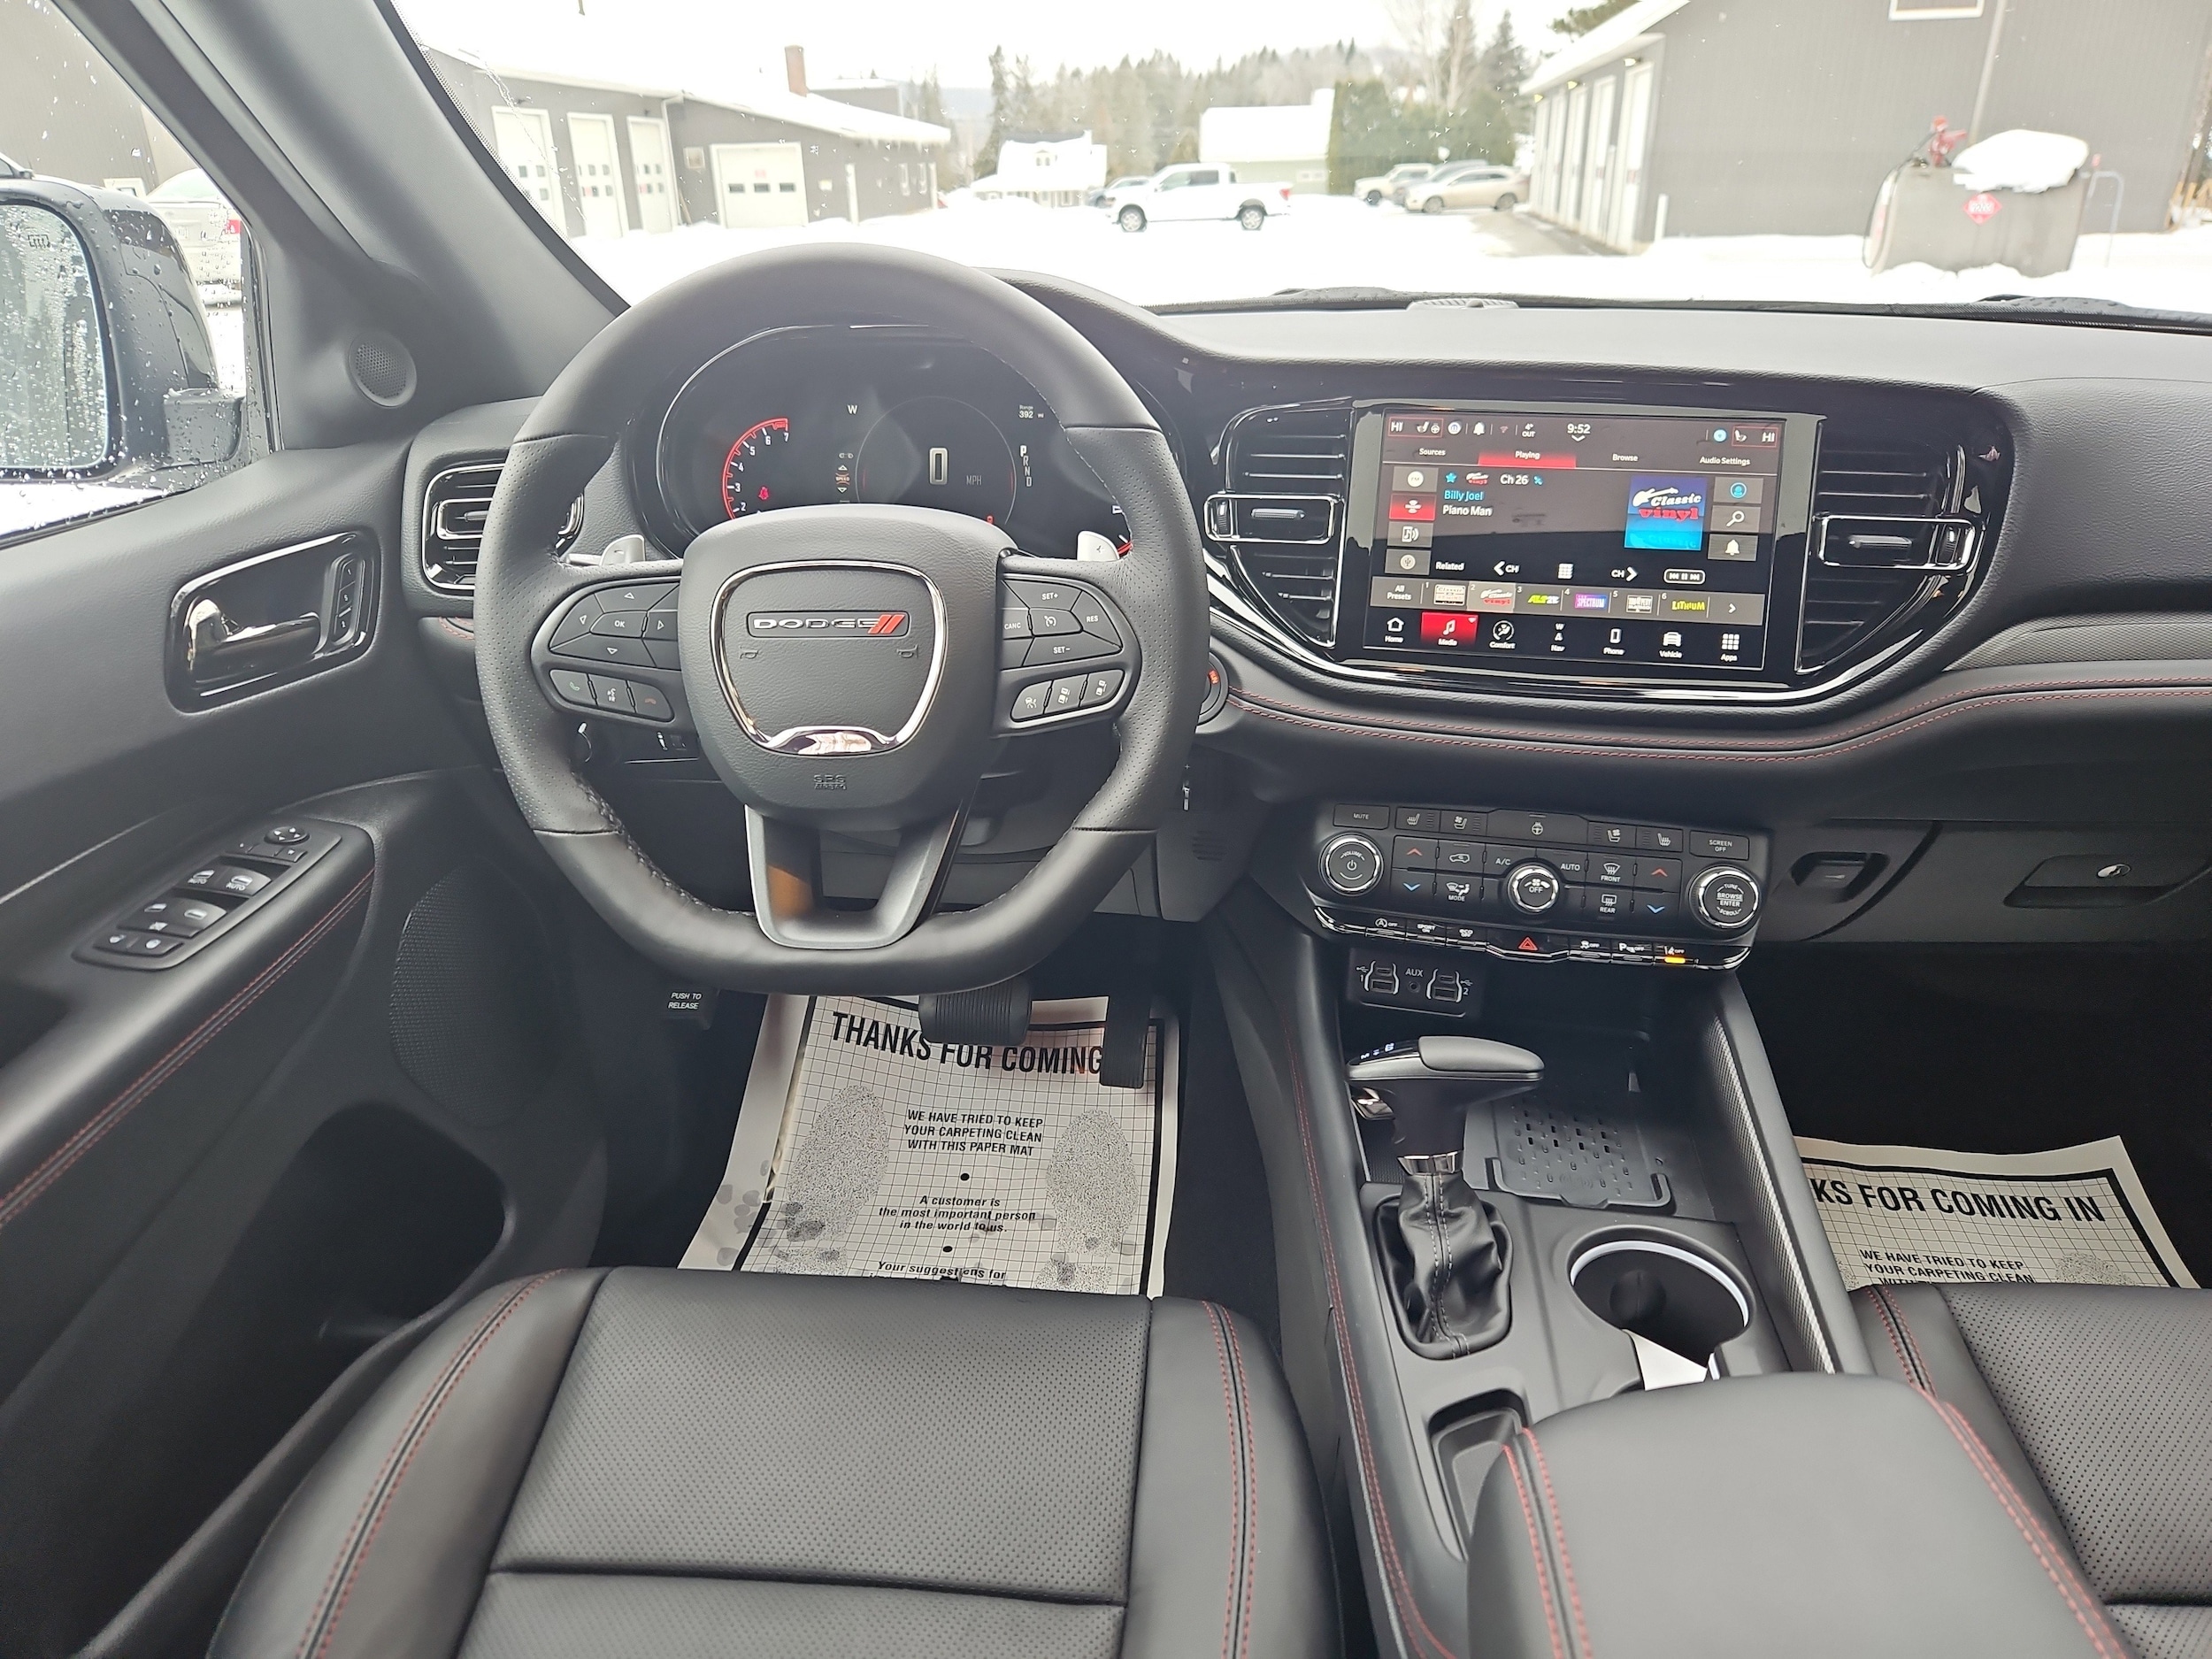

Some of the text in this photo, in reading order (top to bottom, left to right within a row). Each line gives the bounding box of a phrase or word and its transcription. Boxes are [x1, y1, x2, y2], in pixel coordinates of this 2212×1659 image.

[847, 404, 858, 415] W
[1390, 421, 1403, 431] HI
[1567, 424, 1591, 434] 9:52
[764, 436, 772, 446] 6
[783, 432, 790, 442] 7
[1762, 432, 1776, 442] HI
[749, 446, 756, 457] 5
[1418, 448, 1447, 457] Sources
[1515, 450, 1540, 460] Playing
[1612, 453, 1639, 462] Browse
[1700, 456, 1751, 467] Audio Settings
[738, 463, 744, 472] 4
[929, 447, 949, 485] 0
[966, 475, 982, 486] MPH
[1500, 473, 1514, 485] Ch
[1515, 474, 1529, 485] 26
[734, 483, 741, 493] 3
[1444, 489, 1484, 503] Billy Joel
[1650, 493, 1701, 507] Classic
[740, 502, 747, 511] 2
[1442, 505, 1494, 517] Piano Man
[1639, 507, 1699, 522] vinyl
[1435, 562, 1465, 572] Related
[1505, 565, 1520, 574] CH
[1611, 569, 1625, 579] CH
[1386, 592, 1412, 601] Presets
[753, 618, 879, 630] DODGE
[1385, 635, 1404, 644] Home
[1438, 638, 1458, 647] Media
[1602, 647, 1625, 656] Phone
[1659, 650, 1682, 659] Vehicle
[1720, 653, 1738, 663] Apps
[1495, 857, 1511, 866] A/C
[1560, 863, 1581, 872] AUTO
[225, 881, 246, 891] AUTO
[1406, 968, 1424, 977] AUX
[832, 1011, 932, 1060] THANKS
[940, 1043, 991, 1070] FOR
[908, 1110, 1043, 1128] WE HAVE TRIED TO KEEP
[904, 1125, 1042, 1142] YOUR CARPETING CLEAN
[908, 1140, 1034, 1156] WITH THIS PAPER MAT
[919, 1195, 1001, 1207] A customer is
[1857, 1184, 1926, 1211] FOR
[1930, 1188, 2062, 1221] COMING
[2063, 1197, 2106, 1222] IN
[879, 1207, 1036, 1222] the most important person
[899, 1220, 1008, 1233] in the world to us.
[1860, 1249, 2024, 1271] WE HAVE TRIED TO KEEP
[878, 1262, 905, 1271] Your
[988, 1267, 1007, 1279] for
[1864, 1263, 1904, 1275] YOUR
[1908, 1267, 1985, 1281] CARPETING
[1986, 1272, 2035, 1283] CLEAN
